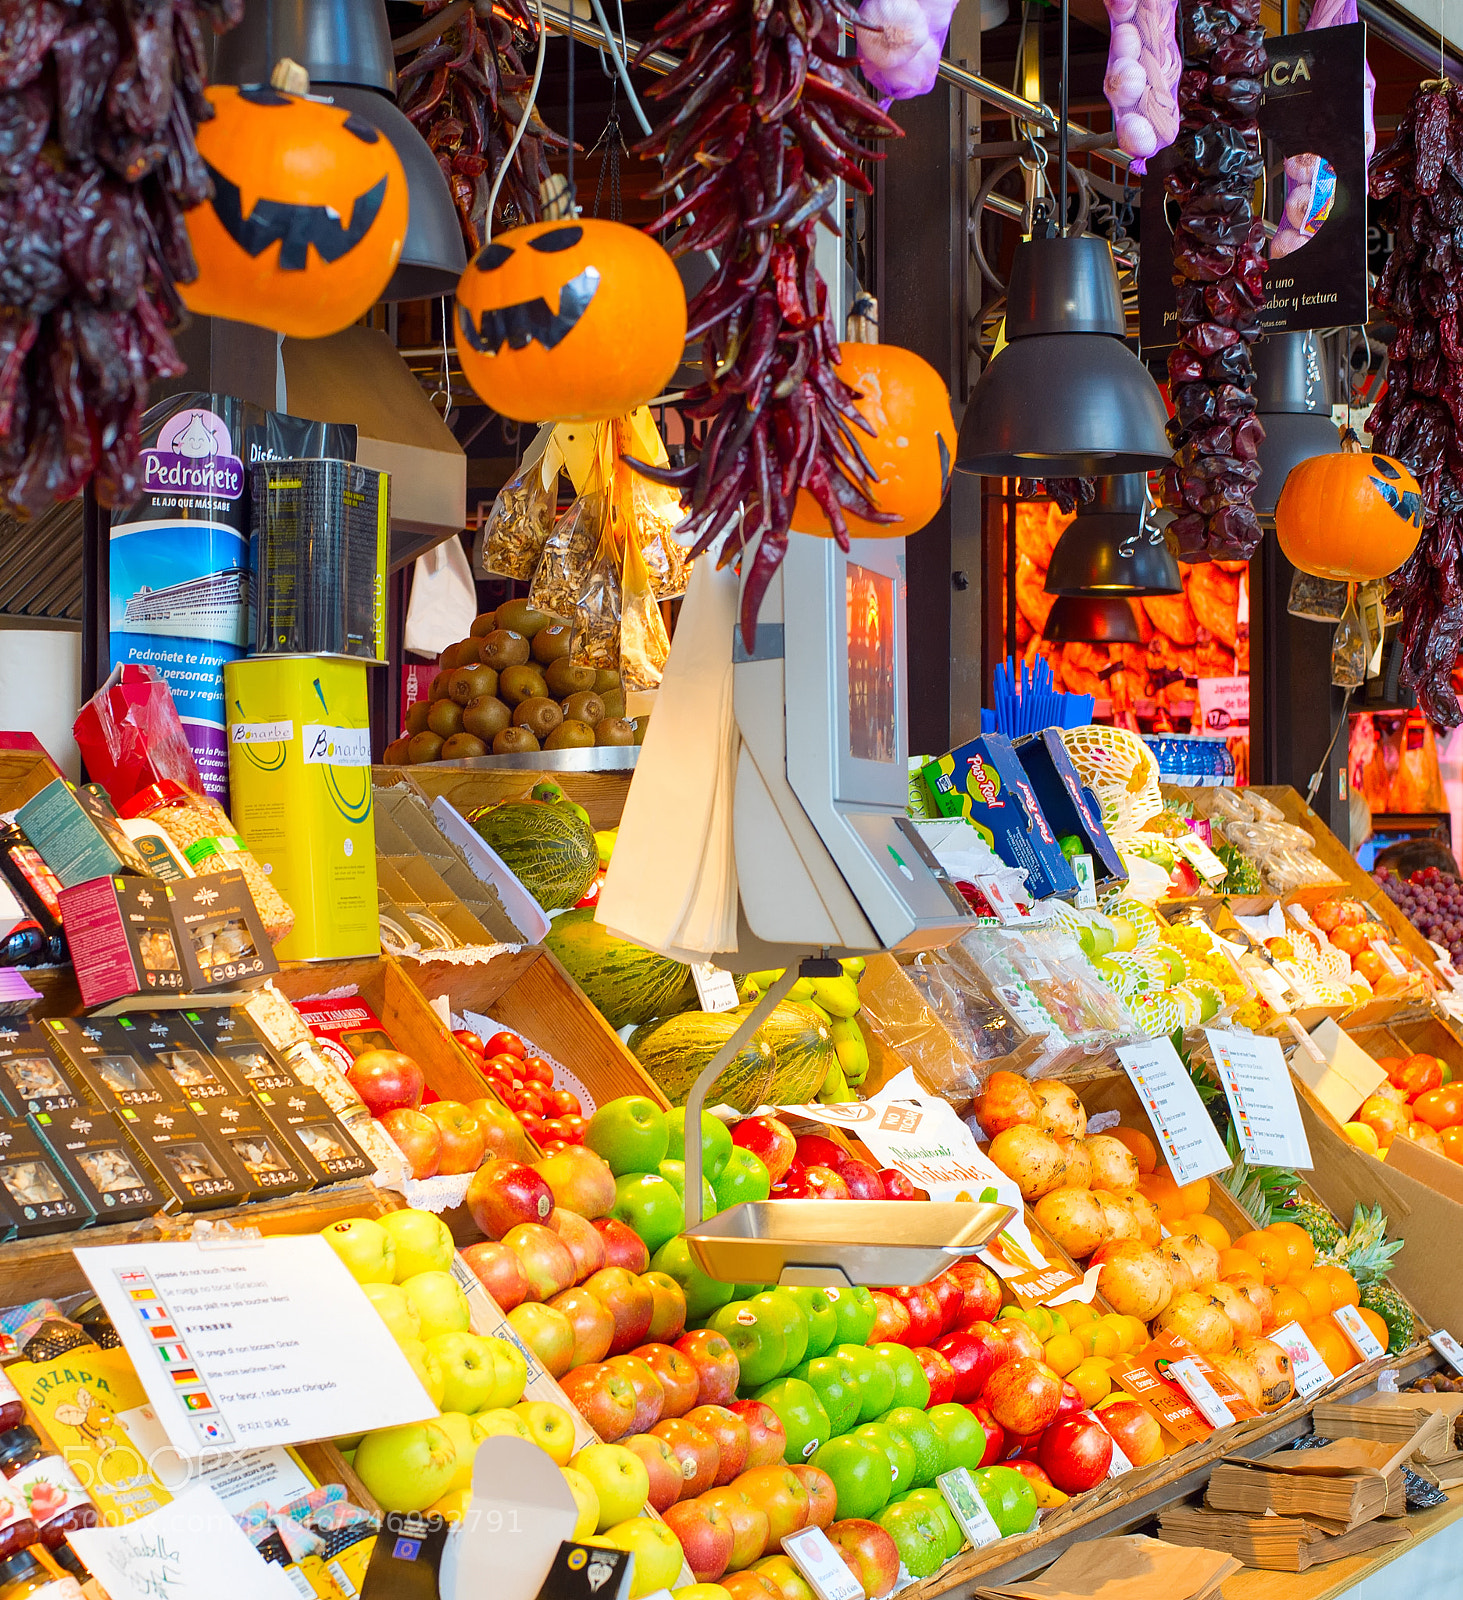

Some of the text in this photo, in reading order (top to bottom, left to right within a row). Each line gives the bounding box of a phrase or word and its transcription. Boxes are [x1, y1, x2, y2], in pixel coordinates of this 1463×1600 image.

[1263, 58, 1311, 88] ICA
[1276, 278, 1294, 289] uno
[1292, 297, 1298, 312] y
[1302, 291, 1338, 306] textura
[144, 455, 238, 491] Pedroñete
[152, 498, 230, 512] EL AJO QUE MÁS SABE
[372, 574, 382, 644] LECTUS
[128, 648, 184, 664] Pedroñete
[186, 654, 198, 664] te
[164, 670, 214, 682] personas
[189, 690, 196, 699] y
[206, 746, 214, 756] la
[198, 758, 224, 768] Crucero
[967, 754, 1005, 810] Paso Real
[301, 1008, 368, 1023] WEET TAMARIND
[885, 1112, 900, 1125] NO
[899, 1110, 919, 1132] TOCAR
[30, 1369, 110, 1406] URZAPA
[220, 1394, 234, 1402] Por
